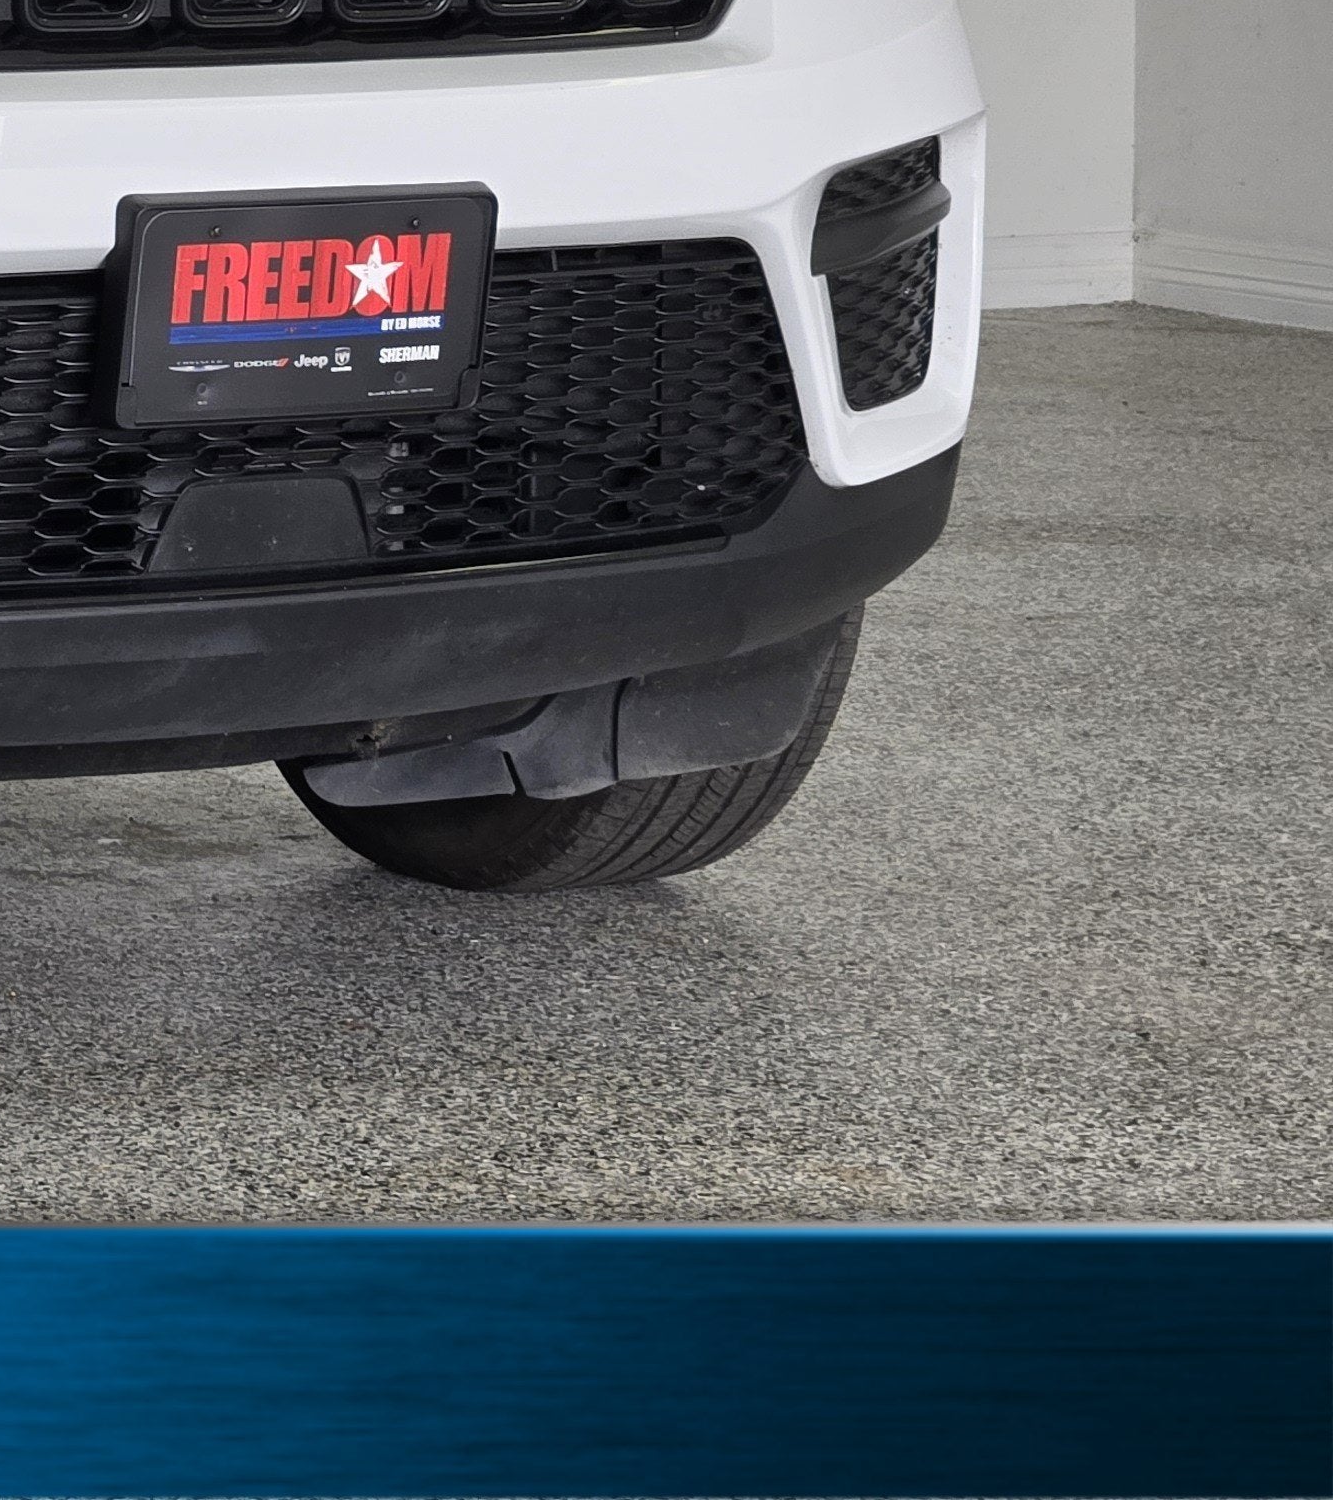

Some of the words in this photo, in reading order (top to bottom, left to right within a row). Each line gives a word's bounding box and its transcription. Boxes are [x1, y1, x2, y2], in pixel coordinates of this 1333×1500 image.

[170, 232, 452, 324] FREEDOM
[294, 354, 328, 369] Jeep
[379, 345, 440, 363] SHERMAN
